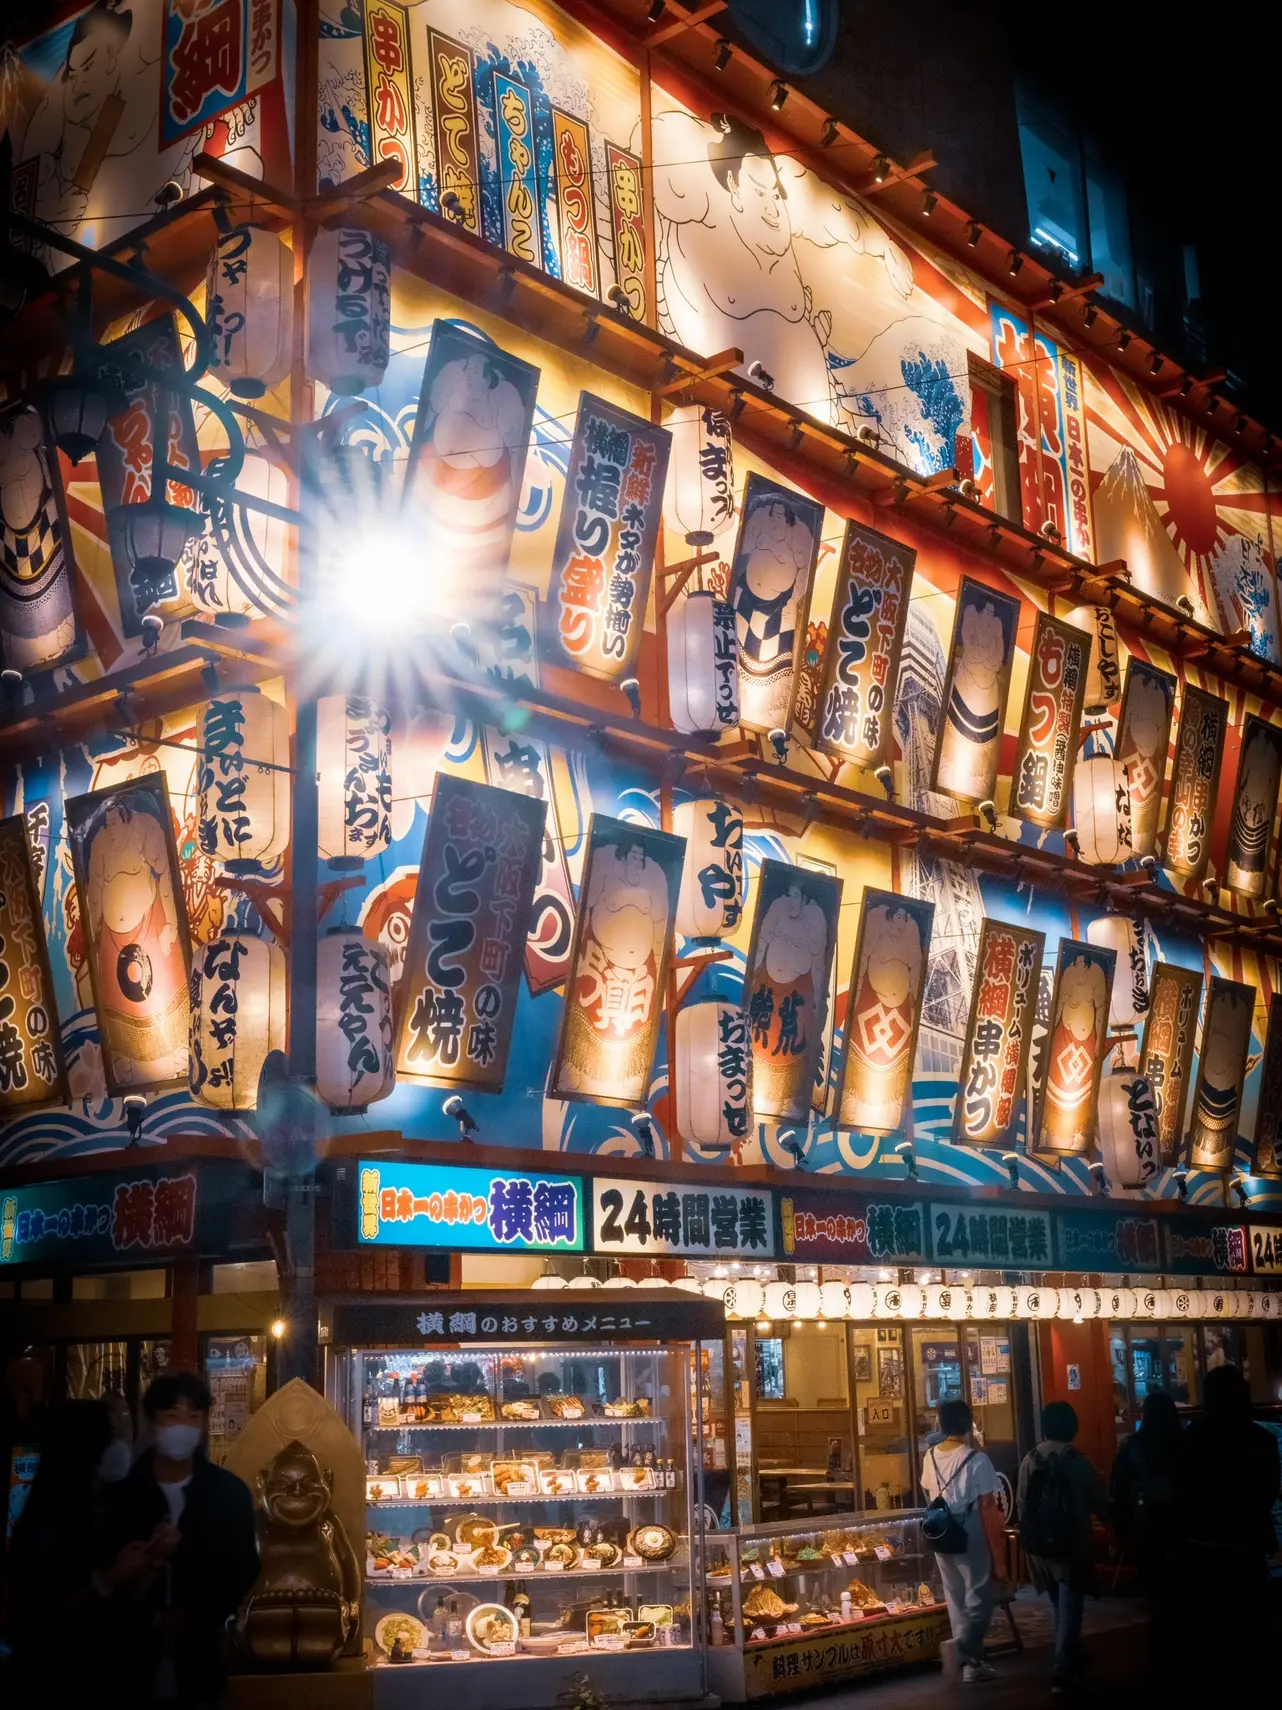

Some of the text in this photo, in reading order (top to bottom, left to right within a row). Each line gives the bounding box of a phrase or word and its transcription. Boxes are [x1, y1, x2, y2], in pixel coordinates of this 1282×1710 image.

[172, 0, 243, 125] 綱
[369, 8, 410, 191] 串かつ
[500, 89, 535, 263] ちゃんこ
[561, 131, 596, 292] もつ鍋
[613, 160, 646, 323] 串かつ
[600, 438, 657, 661] 新鮮ネタが勢揃い
[862, 557, 903, 750] 大阪下町の味
[1018, 627, 1065, 813] もつ鍋
[964, 932, 1015, 1135] 横綱串かつ
[110, 1173, 197, 1251] 横綱
[379, 1185, 489, 1227] 日本一の串かつ
[487, 1178, 578, 1244] 横綱
[600, 1188, 768, 1249] 24時間営業
[866, 1203, 924, 1257] 横綱
[935, 1211, 1047, 1260] 24時間営業
[417, 1311, 651, 1336] 横綱のおすすめメニュー
[873, 1408, 889, 1420] 入口
